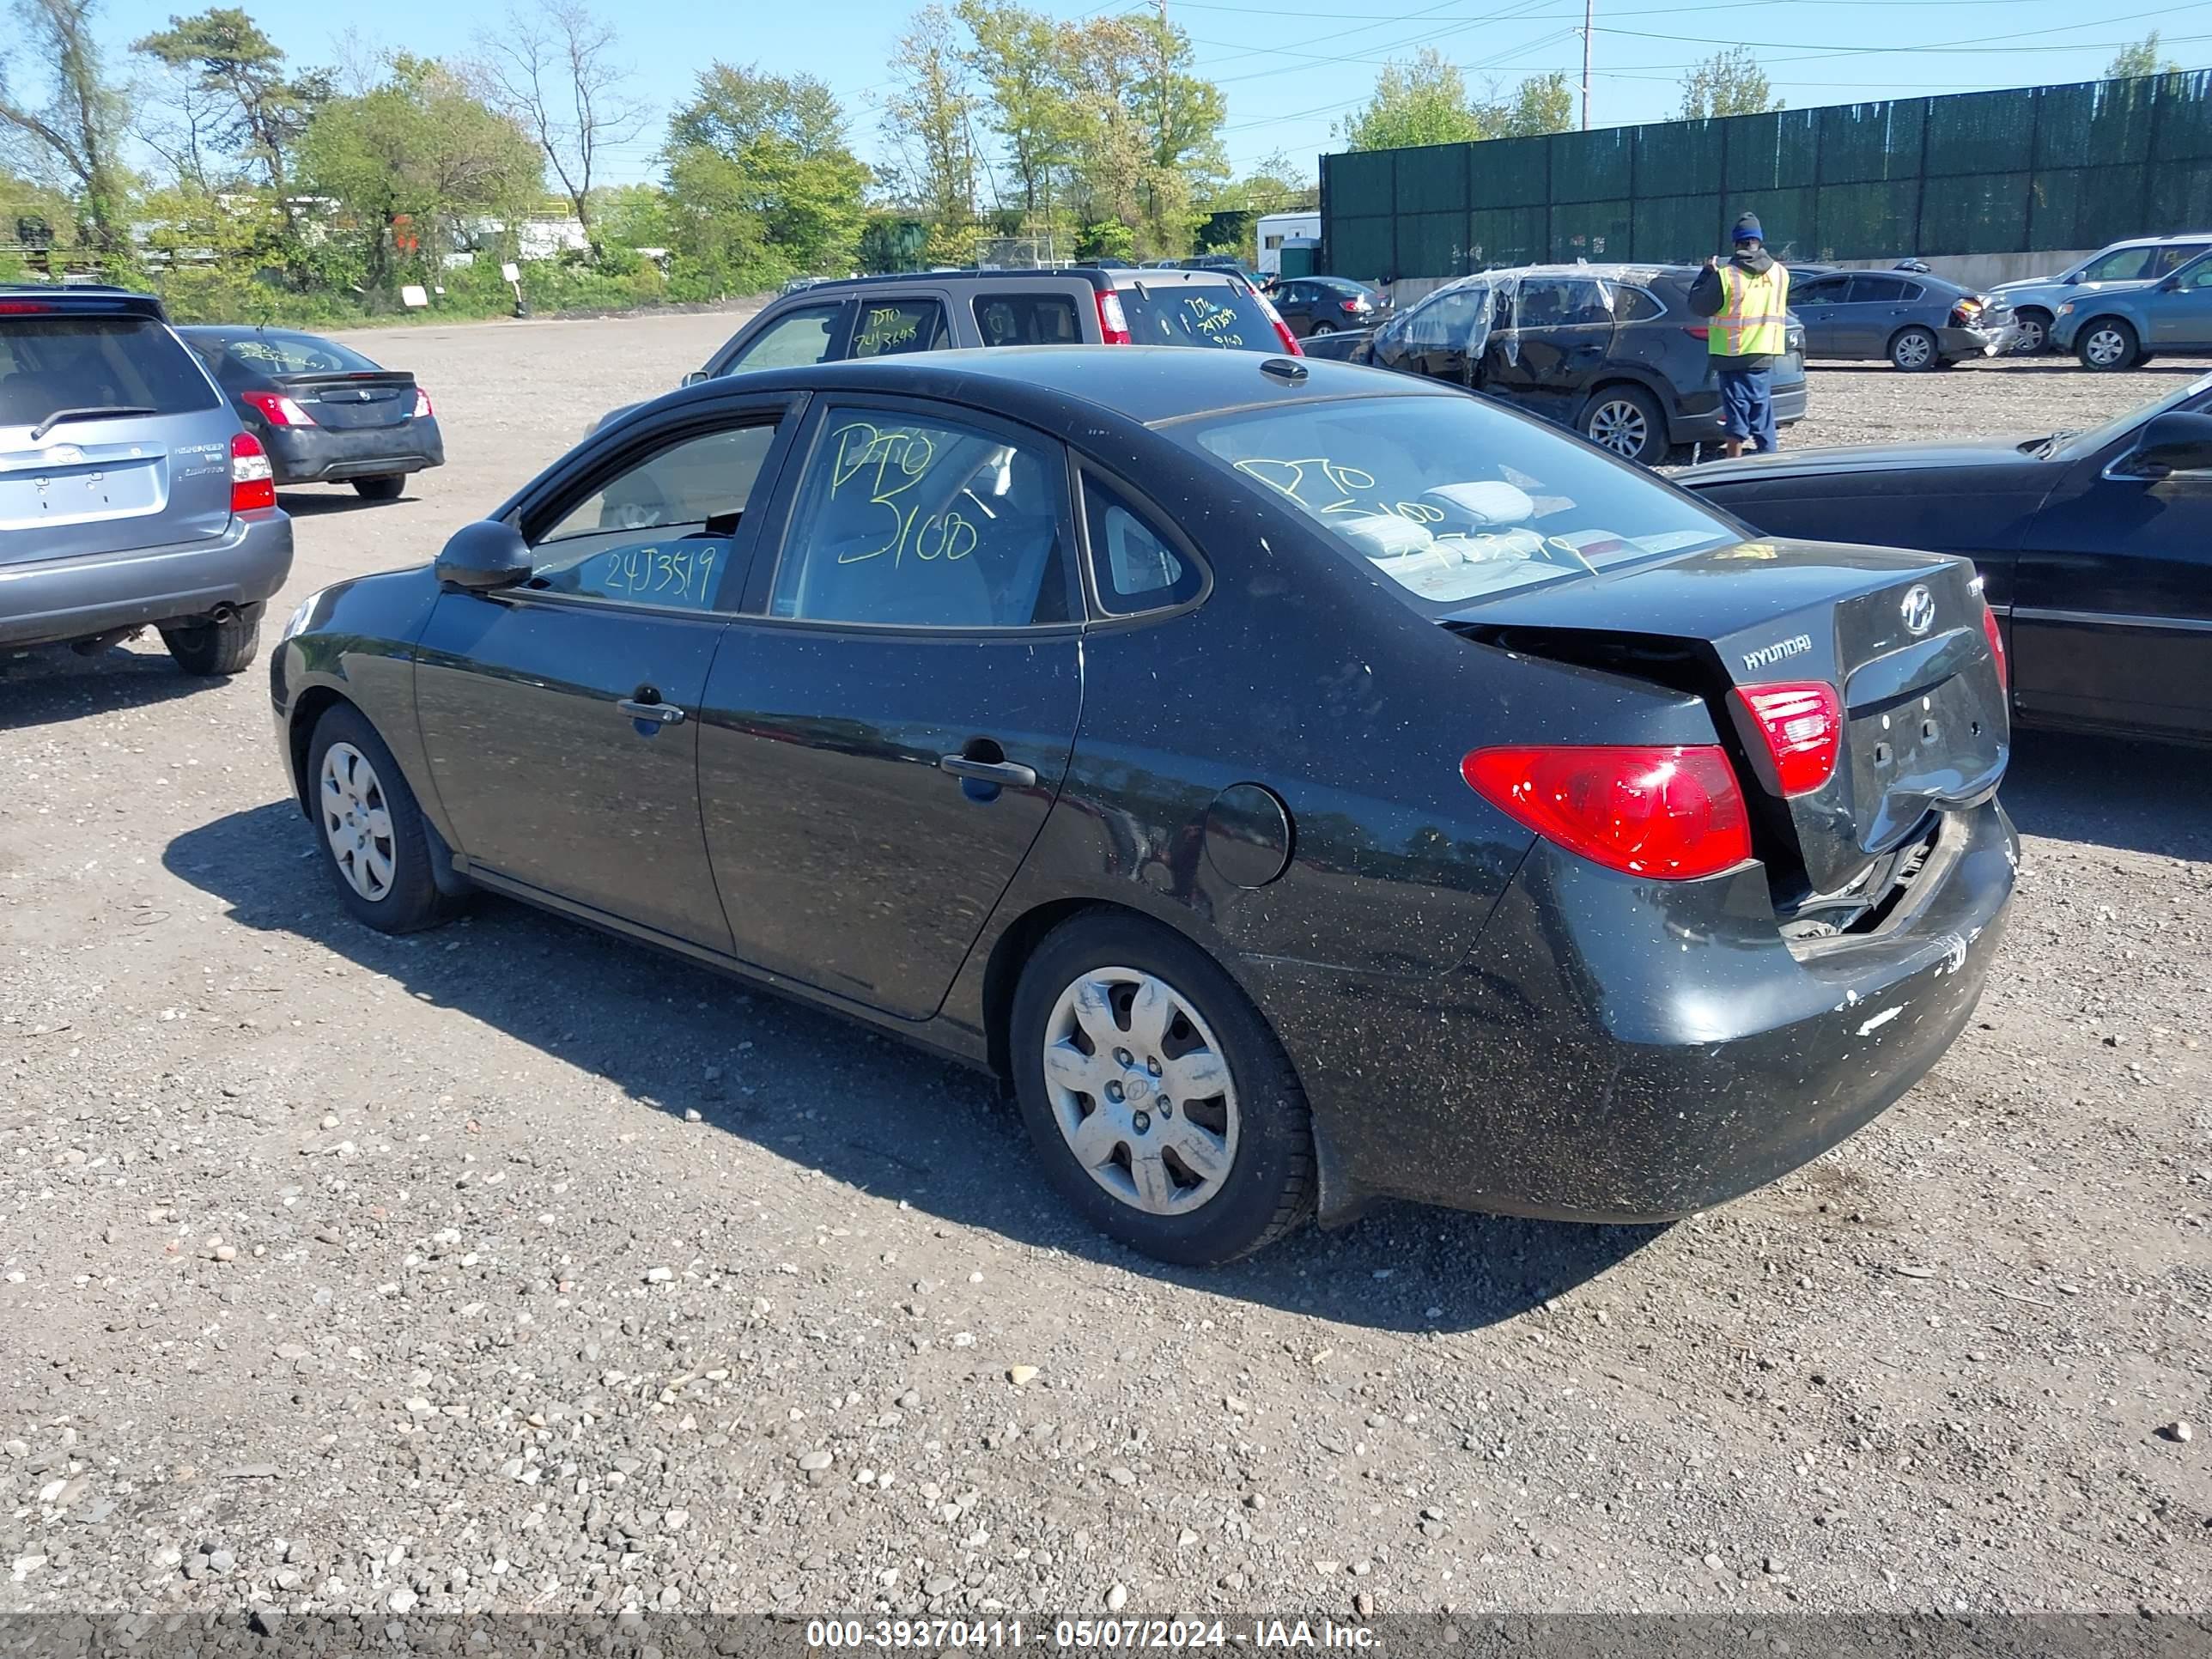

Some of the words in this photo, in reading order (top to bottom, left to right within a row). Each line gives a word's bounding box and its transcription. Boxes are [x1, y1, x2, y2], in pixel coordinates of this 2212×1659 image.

[870, 308, 901, 327] DTO
[831, 422, 933, 501] DTO
[1232, 459, 1376, 508] DTO
[605, 546, 716, 603] 24J3519
[1742, 634, 1812, 672] HYUNDAI
